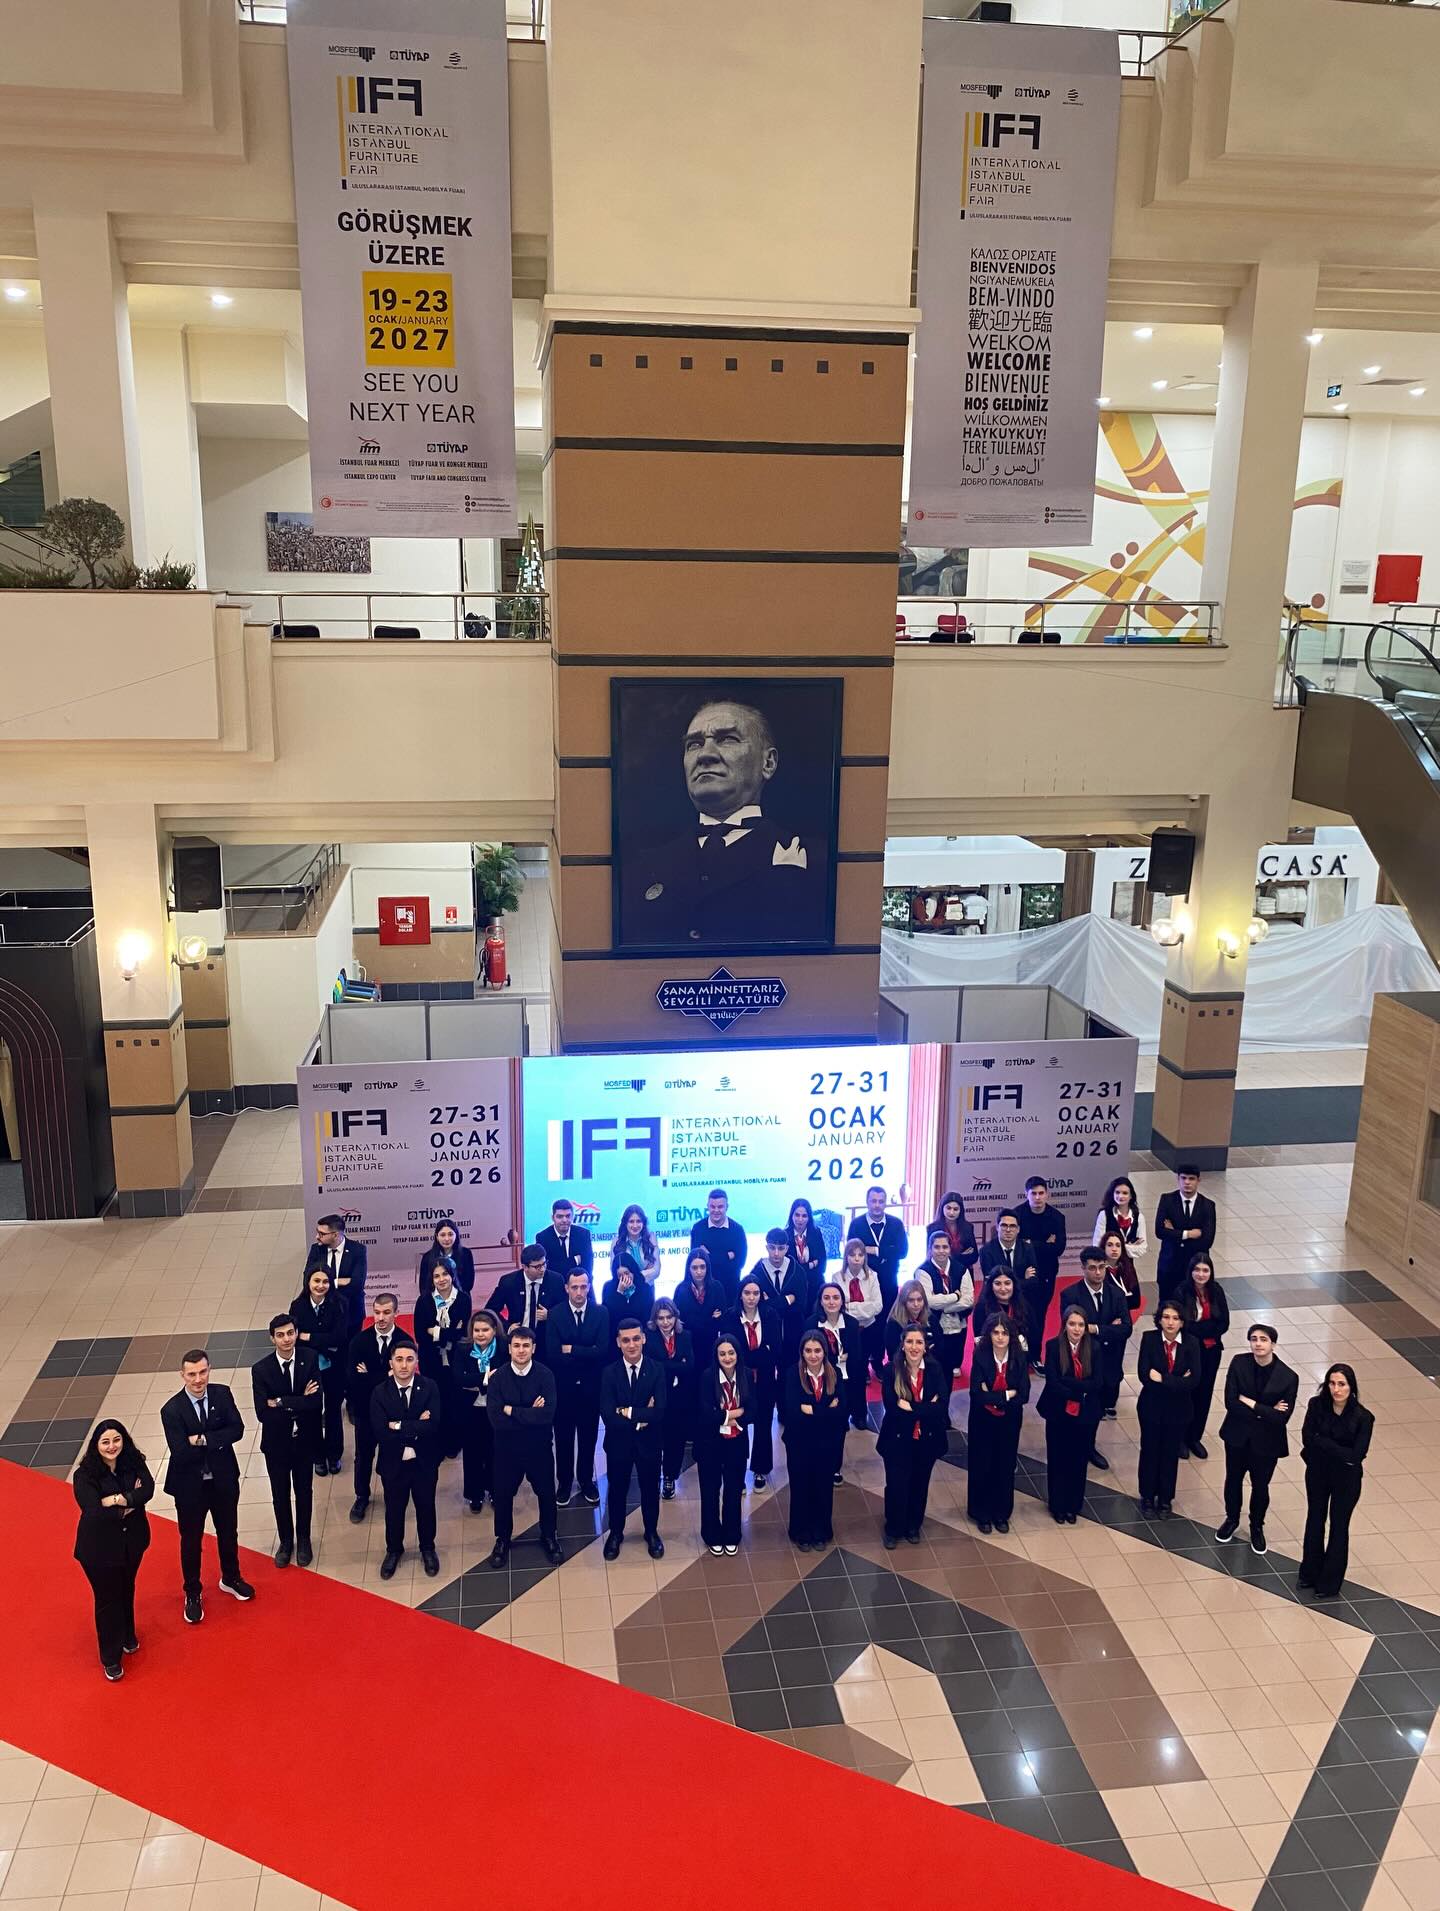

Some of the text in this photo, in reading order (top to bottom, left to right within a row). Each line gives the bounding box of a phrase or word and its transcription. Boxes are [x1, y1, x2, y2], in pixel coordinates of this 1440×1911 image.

[328, 45, 358, 54] MOSFED
[399, 49, 429, 61] TÜYAP
[1024, 87, 1050, 98] TÜYAP
[348, 124, 449, 138] INTERNATIONAL
[348, 138, 411, 149] ISTANBUL
[349, 151, 419, 163] FURNITURE
[971, 157, 1061, 170] INTERNATIONAL
[350, 165, 378, 175] FAIR
[970, 170, 1025, 181] ISTANBUL
[970, 183, 1031, 194] FURNITURE
[969, 196, 994, 206] FAIR
[337, 208, 473, 239] GÖRÜŞMEK
[369, 240, 445, 266] ÜZERE
[970, 248, 1009, 260] ΚΑΛΩΣ
[970, 261, 1056, 275] BIENVENIDOS
[969, 275, 1055, 287] NGIYANEMUKELA
[968, 287, 1054, 308] BEM-VINDO
[968, 308, 1053, 333] 歡迎光臨
[370, 328, 449, 351] 2027
[968, 333, 1051, 352] WELKOM
[967, 352, 1051, 371] WELCOME
[364, 373, 458, 393] SEE YOU
[965, 373, 1050, 394] BIENVENUE
[964, 394, 1049, 414] HOŞ GELDİNİZ
[350, 402, 475, 424] NEXT YEAR
[964, 414, 1048, 426] WILLKOMMEN
[963, 427, 1047, 440] HAYKUYKUY!
[360, 443, 380, 454] ifm
[437, 441, 468, 453] TÜYAP
[963, 440, 1046, 455] TERE TULEMAST
[408, 459, 424, 467] TÜYAP
[961, 478, 988, 486] ДОБРО
[1260, 855, 1345, 876] CASA
[664, 984, 780, 996] SANA MİNNETTARIZ
[664, 994, 780, 1006] SEVGİLİ ATATÜRK
[1013, 1058, 1035, 1066] TÜYAP
[374, 1081, 398, 1090] TÜYAP
[673, 1079, 696, 1088] TÜYAP
[810, 1070, 890, 1095] 27-31
[1059, 1081, 1122, 1099] 27-31
[429, 1104, 499, 1125] 27-31
[808, 1105, 886, 1130] OCAK
[1058, 1104, 1120, 1122] OCAK
[672, 1115, 782, 1129] INTERNATIONAL
[964, 1116, 1040, 1125] INTERNATIONAL
[964, 1126, 1010, 1134] ISTANBUL
[1057, 1123, 1119, 1135] JANUARY
[430, 1129, 500, 1149] OCAK
[671, 1132, 739, 1144] ISTANBUL
[808, 1131, 886, 1147] JANUARY
[963, 1135, 1015, 1143] FURNITURE
[324, 1142, 410, 1153] INTERNATIONAL
[671, 1145, 747, 1158] FURNITURE
[1055, 1140, 1118, 1158] 2026
[325, 1153, 377, 1163] ISTANBUL
[430, 1149, 500, 1163] JANUARY
[325, 1163, 384, 1172] FURNITURE
[671, 1162, 702, 1173] FAIR
[808, 1156, 884, 1181] 2026
[325, 1174, 349, 1182] FAIR
[431, 1166, 501, 1187] 2026
[671, 1180, 715, 1188] ULUSLARARASI
[972, 1180, 992, 1191] ifm
[419, 1208, 454, 1219] TÜYAP
[360, 1225, 380, 1233] MERKEZİ
[668, 1247, 680, 1255] AND
